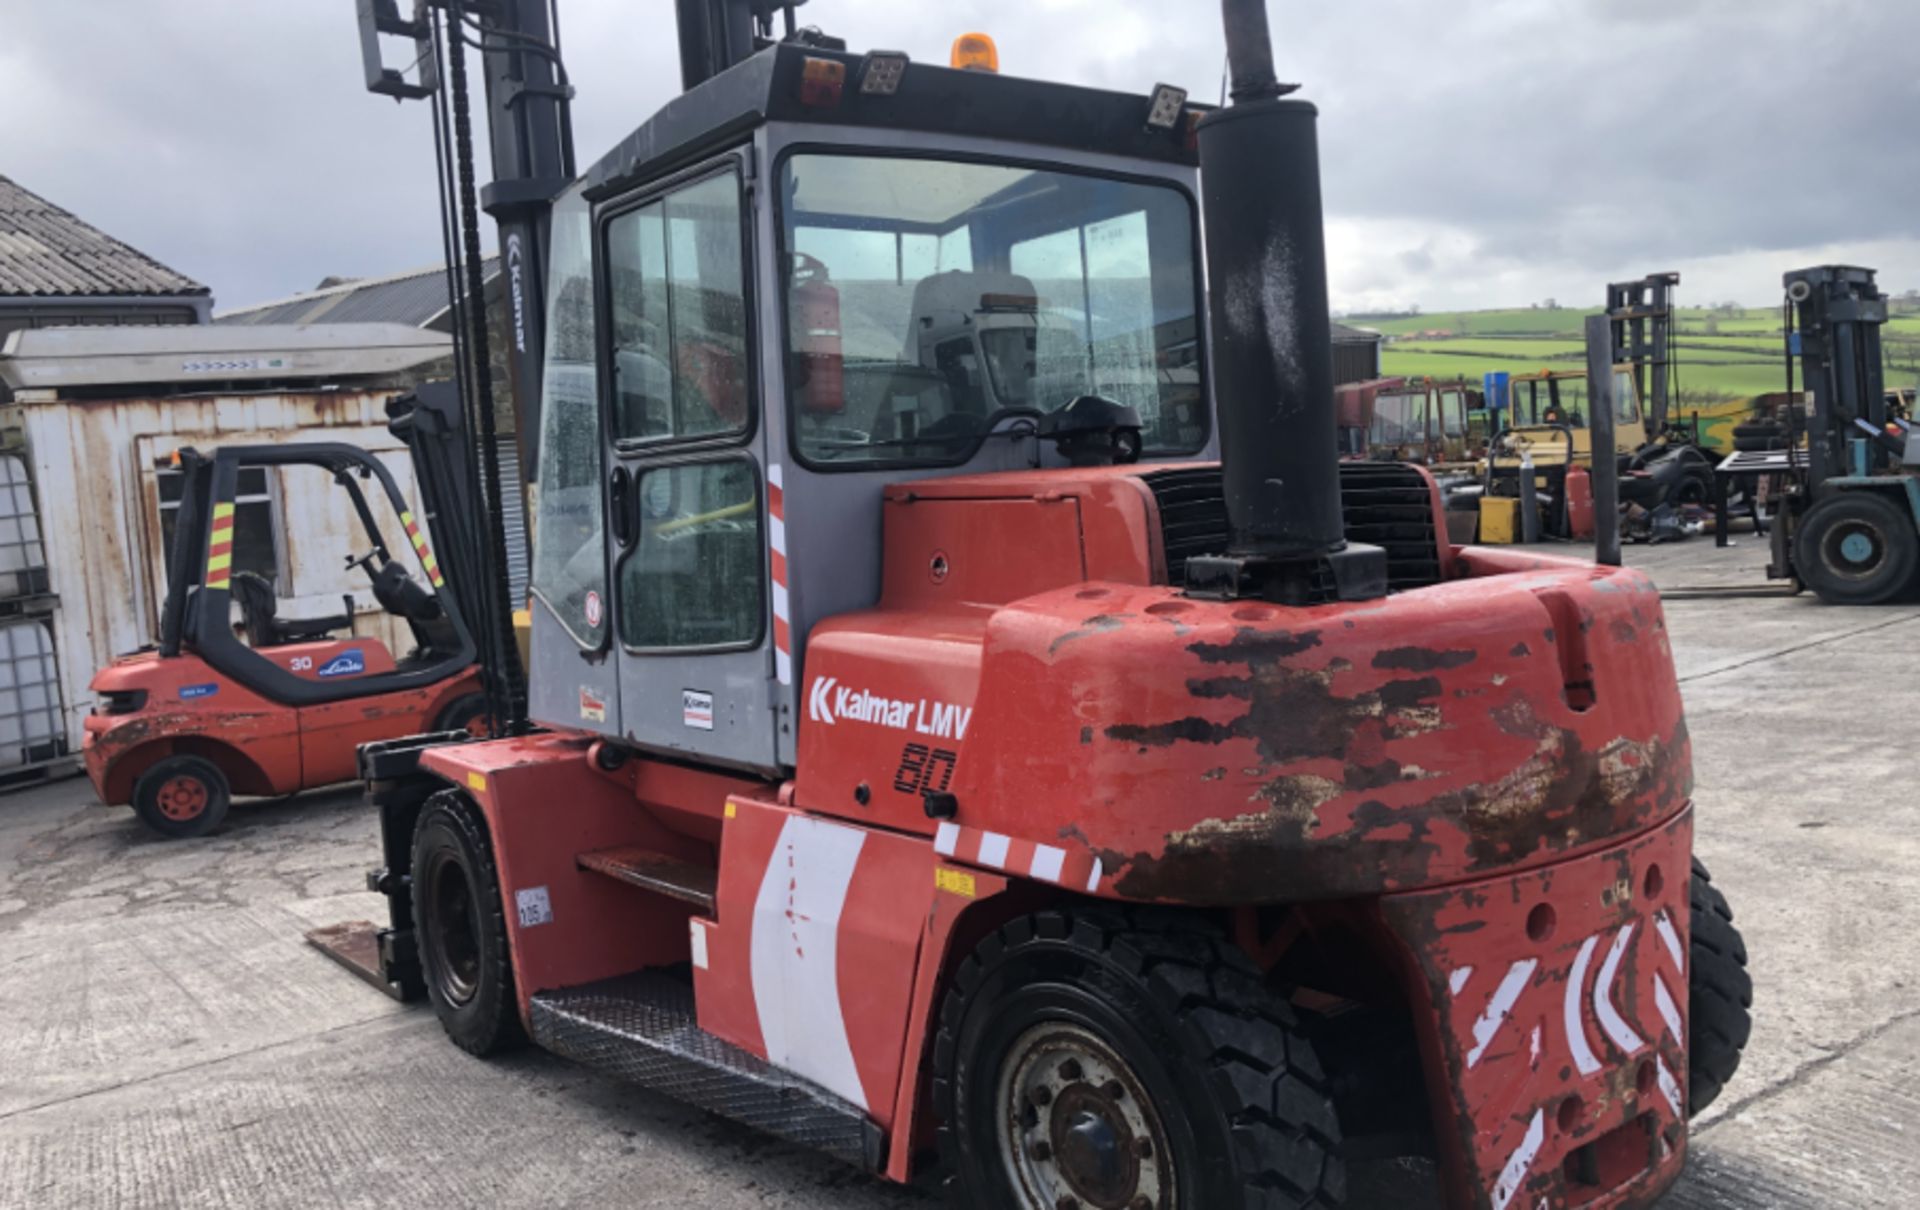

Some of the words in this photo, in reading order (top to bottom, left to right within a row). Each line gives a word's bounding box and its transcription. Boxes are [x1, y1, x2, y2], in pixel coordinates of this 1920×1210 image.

[511, 265, 526, 352] Kalmar
[290, 656, 313, 671] 30
[834, 686, 915, 730] Kalmar
[915, 699, 973, 741] LMV
[894, 742, 957, 798] 80
